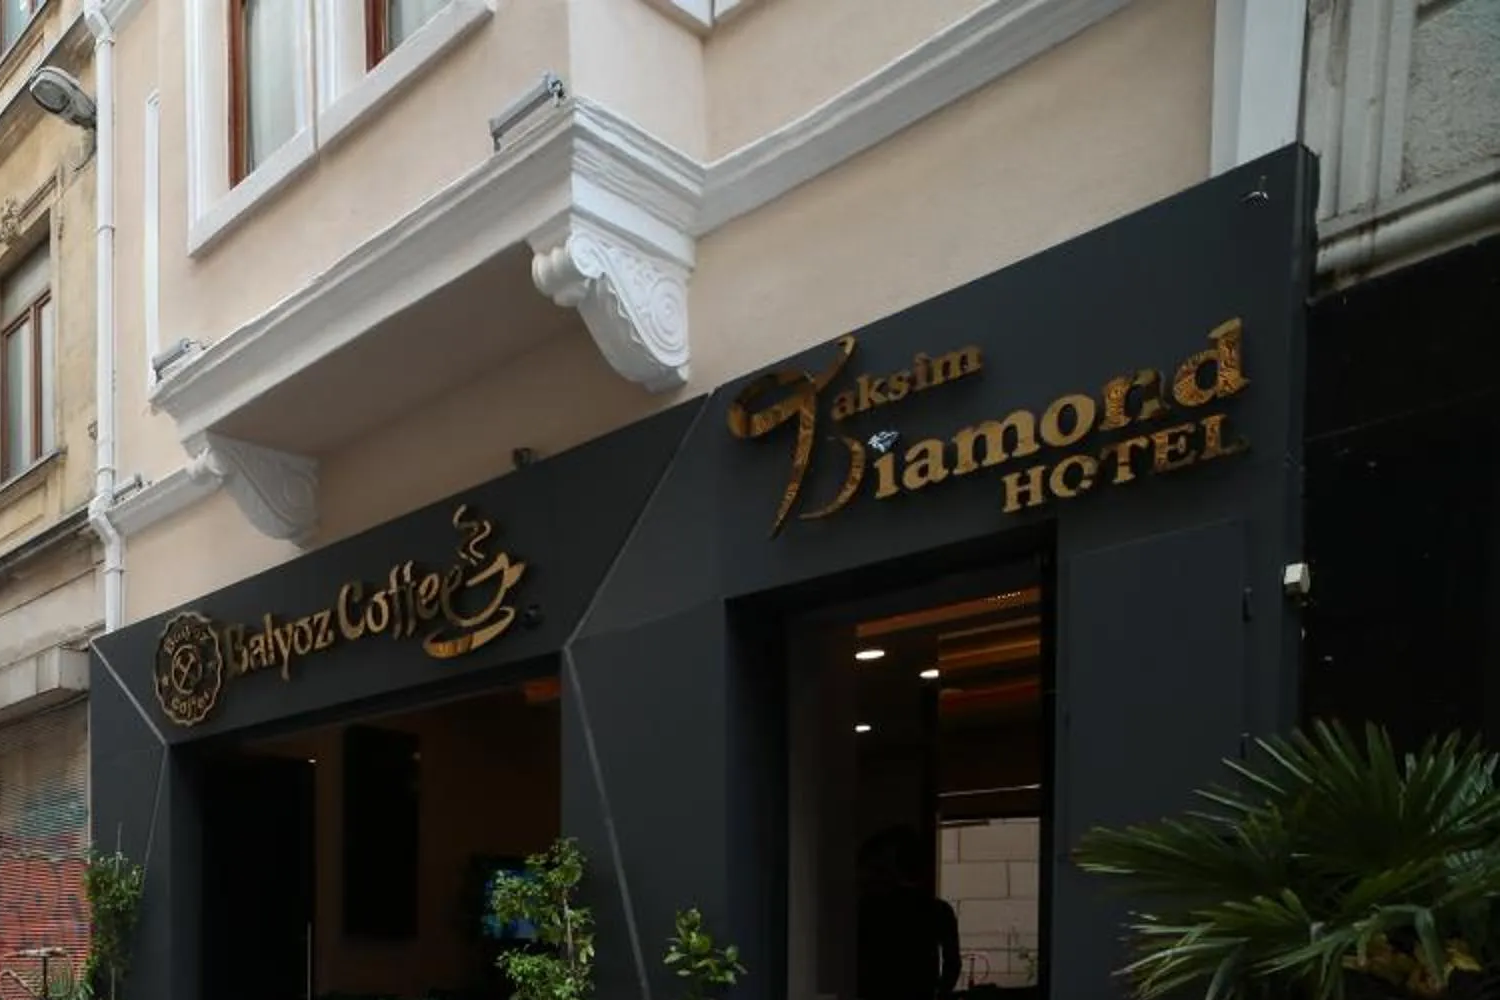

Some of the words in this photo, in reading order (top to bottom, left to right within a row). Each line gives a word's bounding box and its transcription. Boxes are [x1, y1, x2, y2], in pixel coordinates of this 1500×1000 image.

[785, 317, 1251, 518] Diamond
[1002, 413, 1250, 514] HOTEL
[338, 553, 520, 641] Coffee
